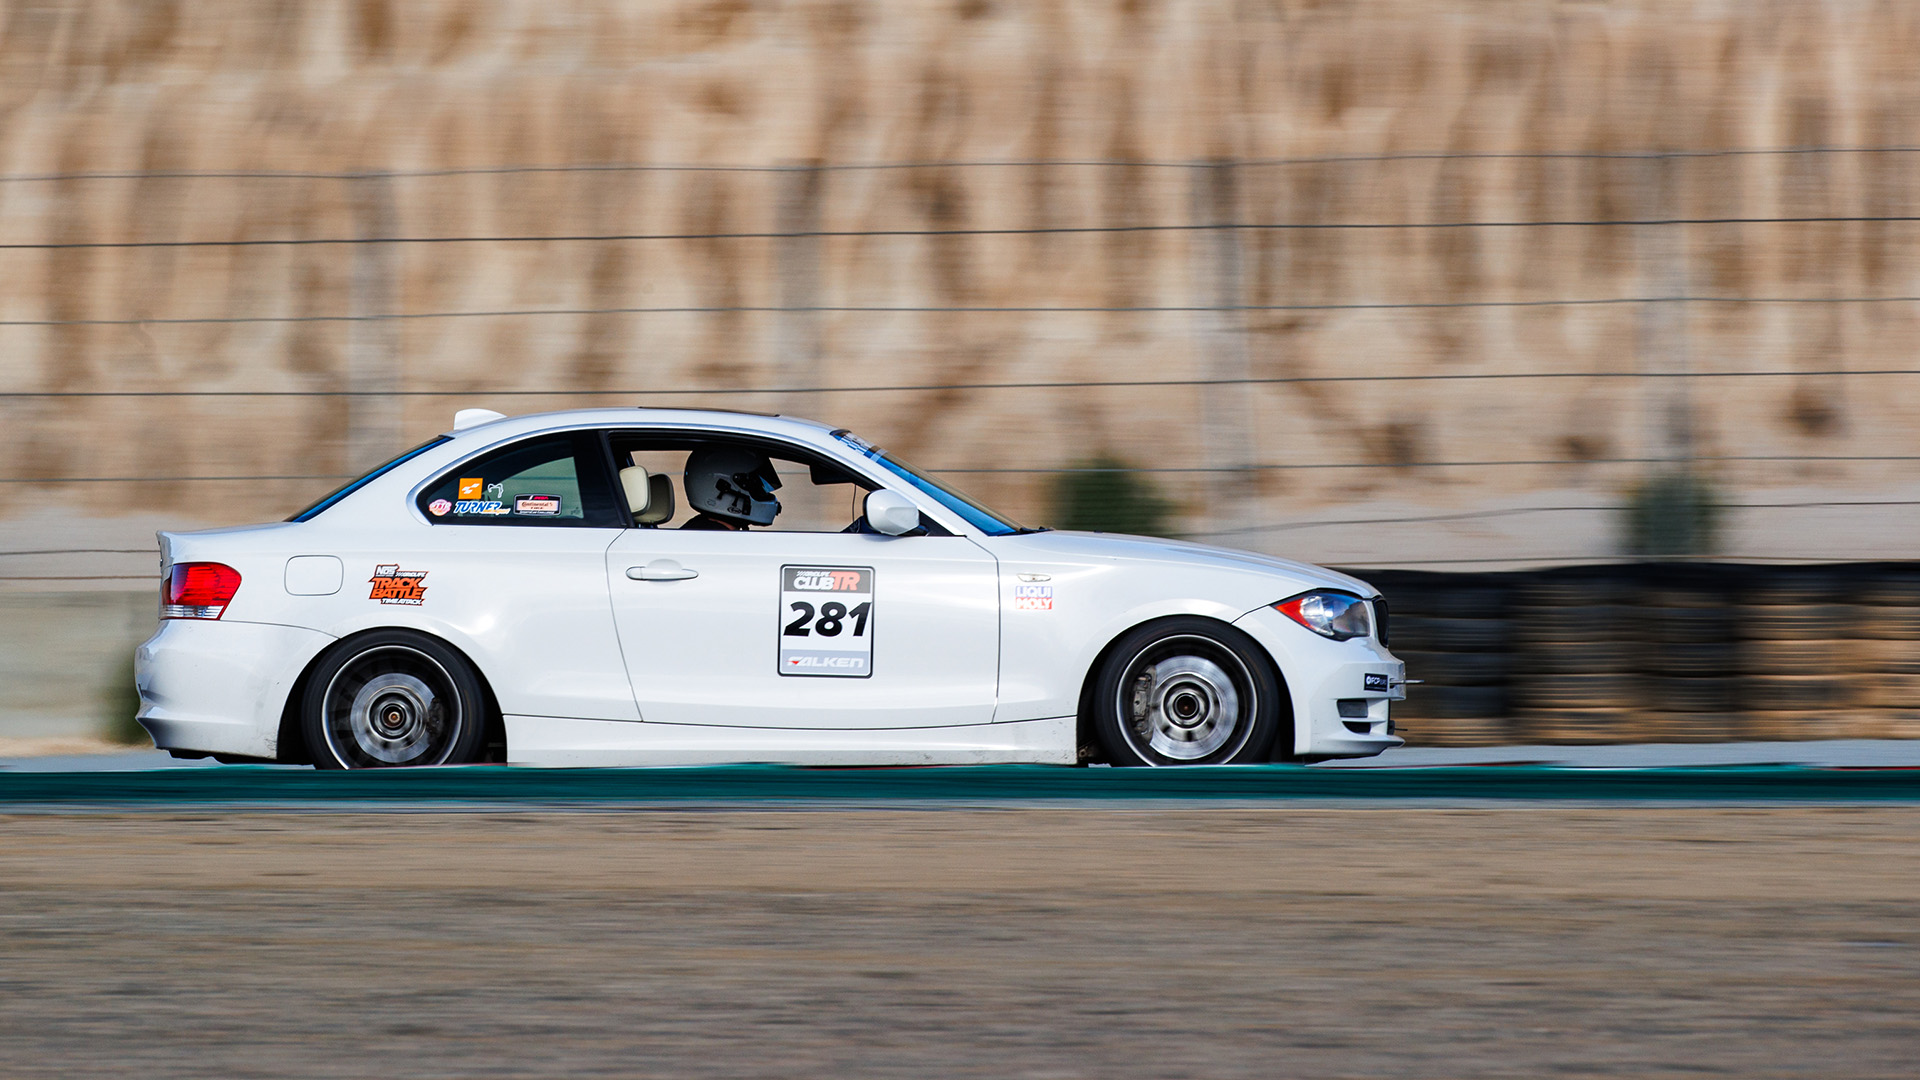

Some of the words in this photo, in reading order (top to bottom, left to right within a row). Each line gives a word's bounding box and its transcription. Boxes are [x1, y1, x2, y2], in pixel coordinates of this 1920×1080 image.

[454, 502, 501, 513] TURNER
[371, 578, 423, 588] TRACK
[370, 588, 425, 599] BATTLE
[1016, 586, 1052, 598] LIQUI
[1016, 598, 1052, 609] MOLY
[783, 601, 872, 637] 281
[786, 656, 864, 668] FALKEN
